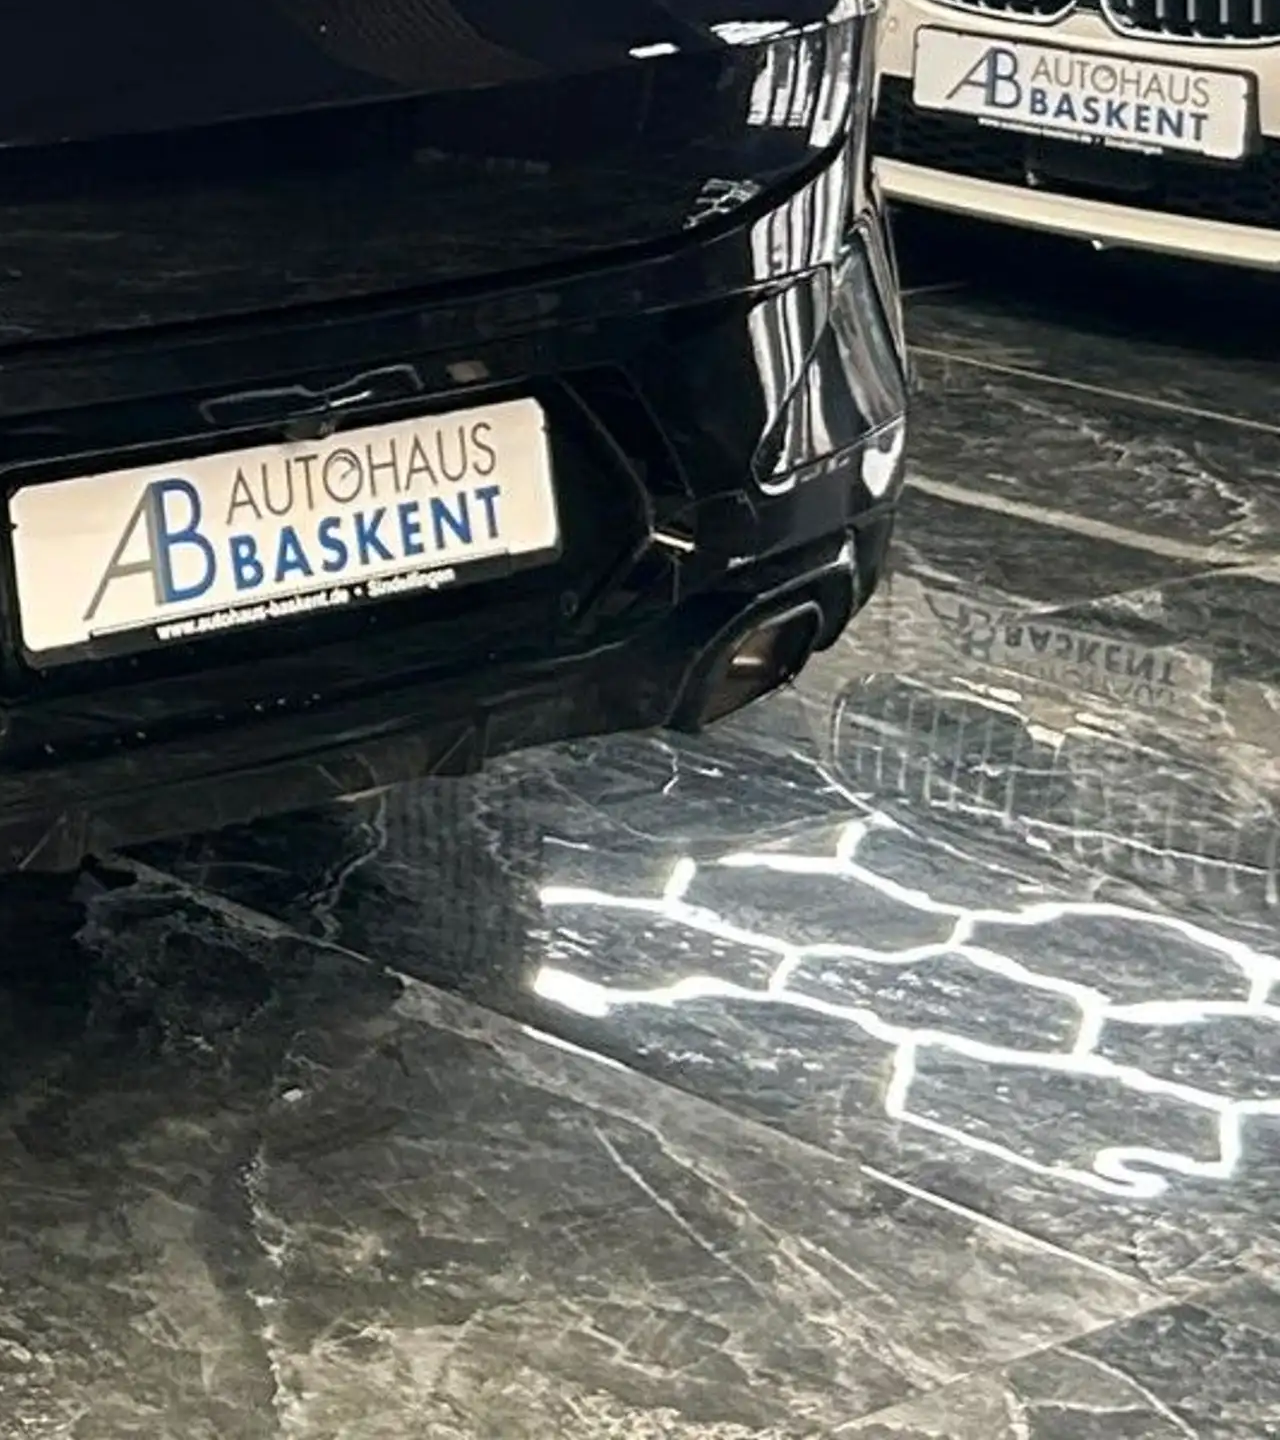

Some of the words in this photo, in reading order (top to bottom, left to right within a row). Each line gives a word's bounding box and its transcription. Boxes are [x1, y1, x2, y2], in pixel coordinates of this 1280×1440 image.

[1029, 87, 1209, 141] BASKENT
[1031, 55, 1210, 108] AUTOHAUS
[226, 421, 498, 526] AUTOHAUS
[230, 485, 500, 589] BASKENT
